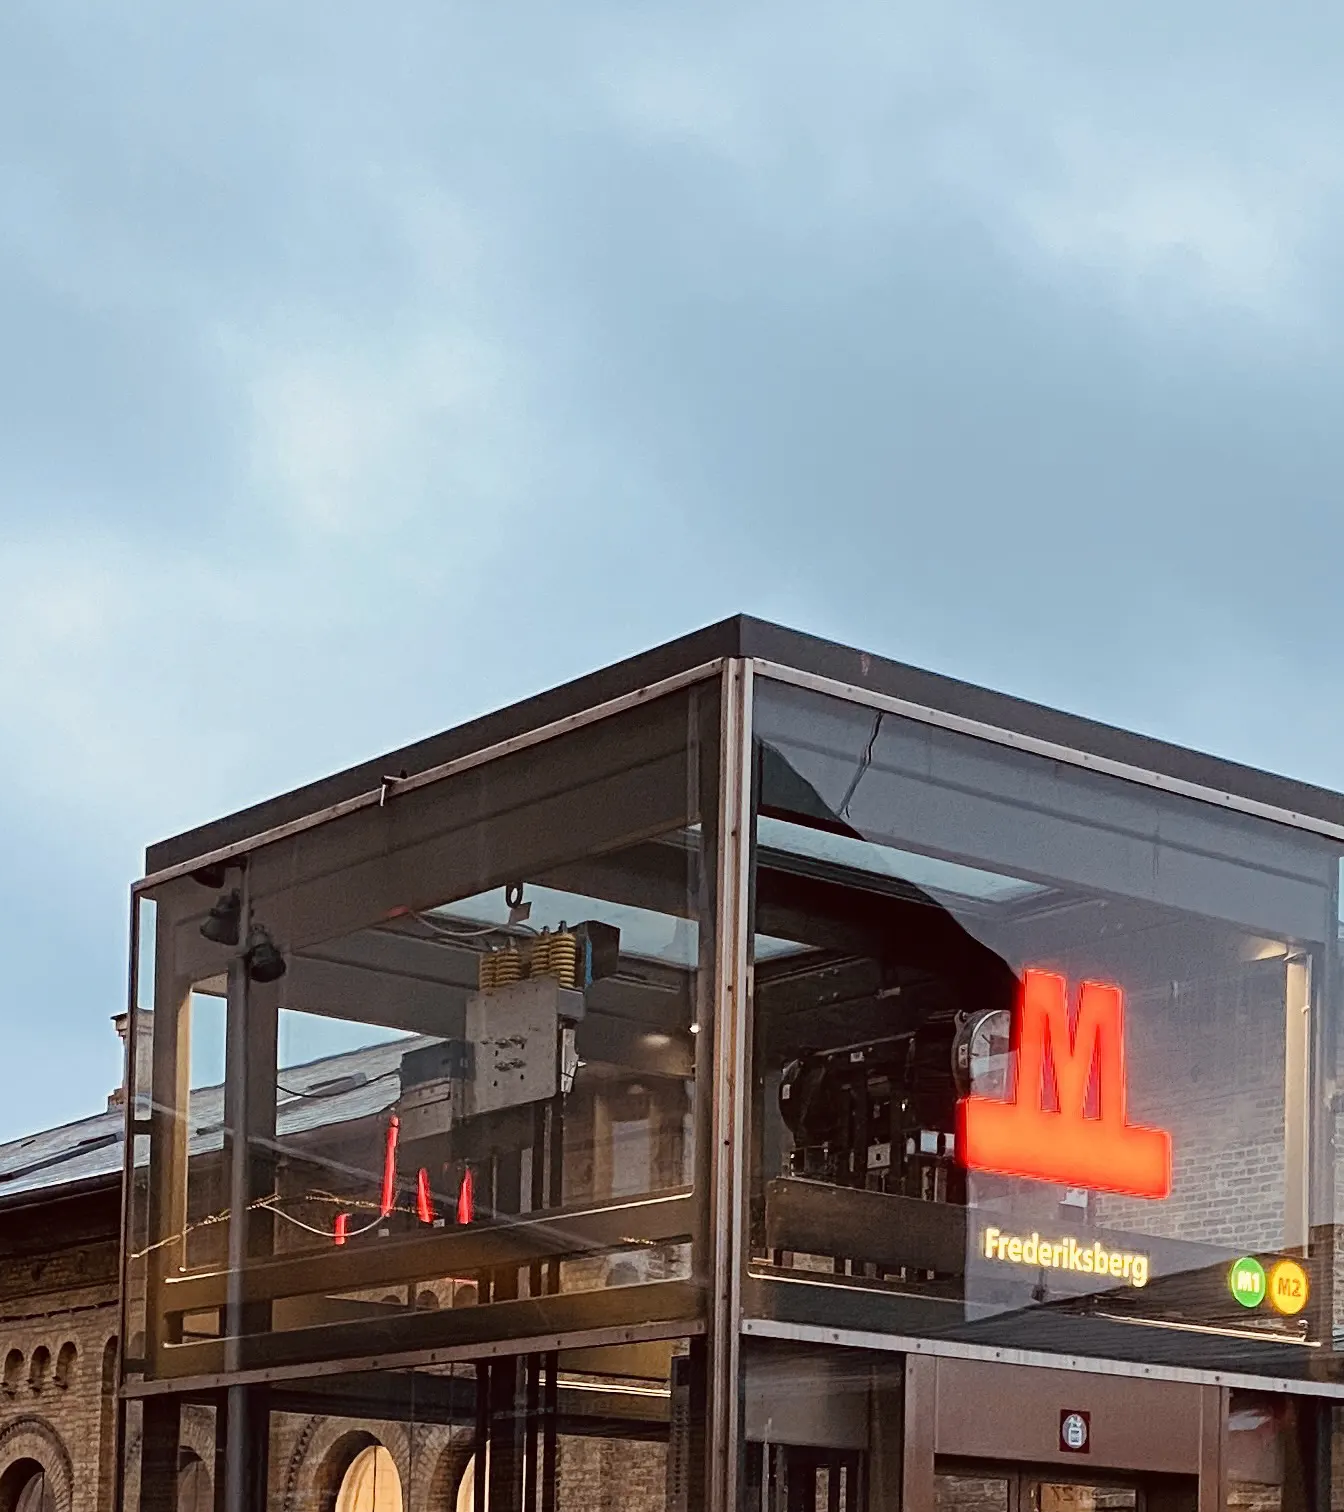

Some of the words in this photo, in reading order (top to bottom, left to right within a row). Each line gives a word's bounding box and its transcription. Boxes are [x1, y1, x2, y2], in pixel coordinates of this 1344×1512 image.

[985, 1228, 1148, 1287] Frederiksberg
[1237, 1270, 1261, 1293] M1
[1278, 1276, 1302, 1298] M2
